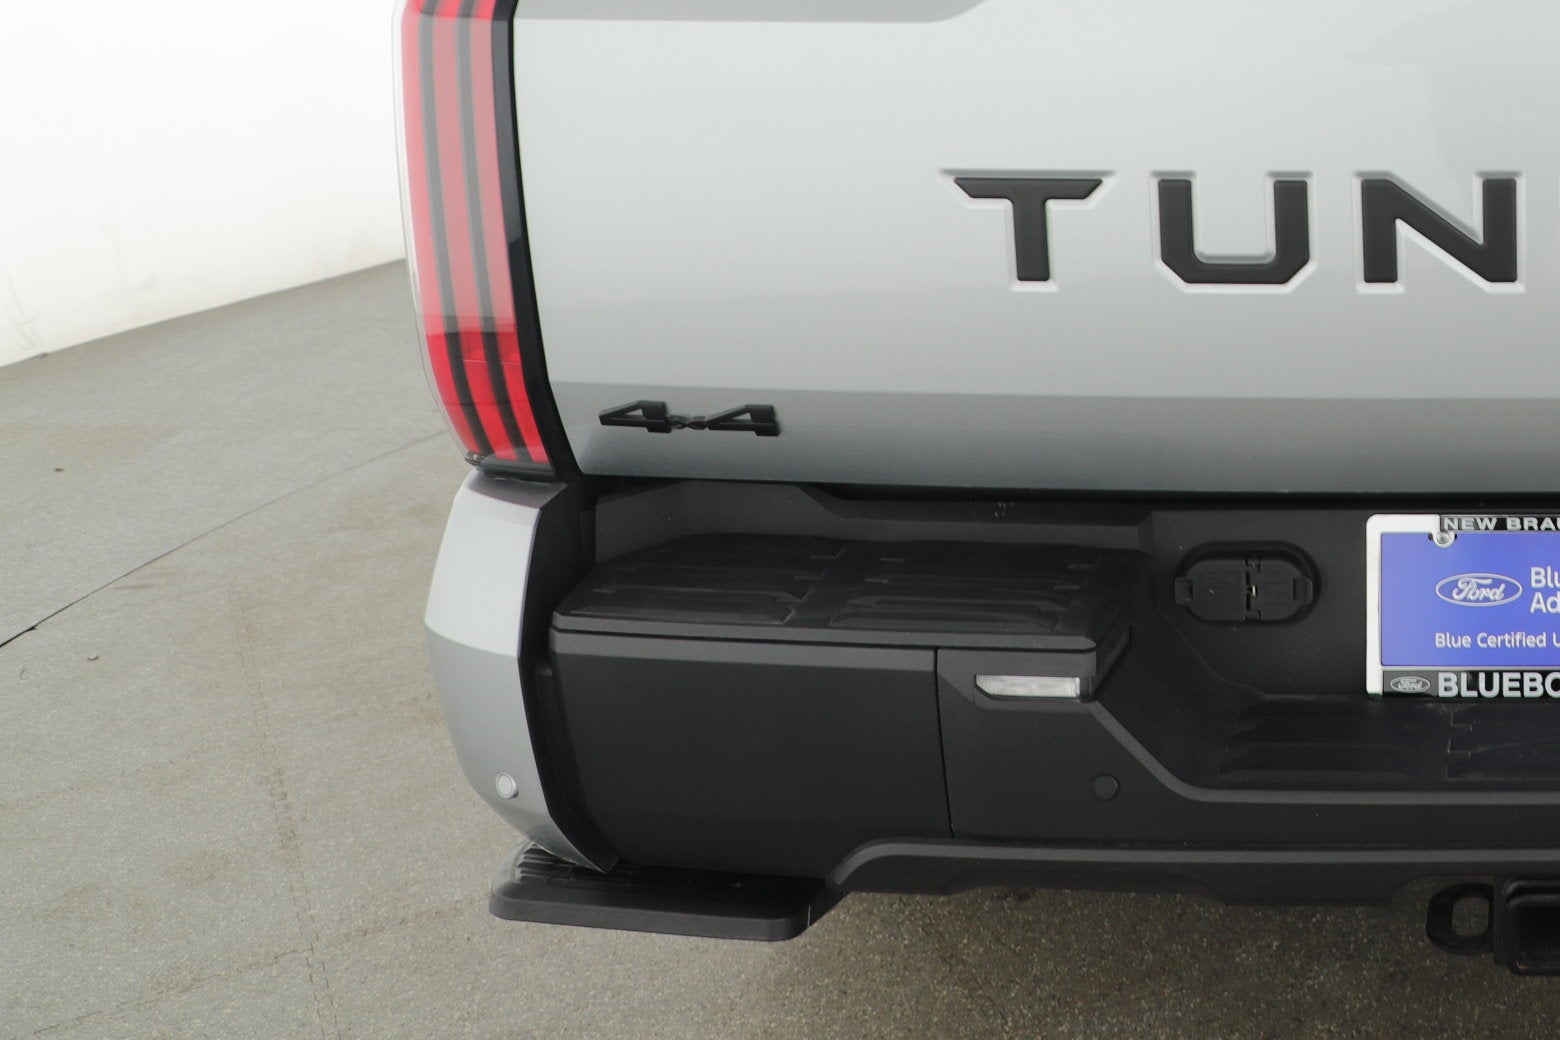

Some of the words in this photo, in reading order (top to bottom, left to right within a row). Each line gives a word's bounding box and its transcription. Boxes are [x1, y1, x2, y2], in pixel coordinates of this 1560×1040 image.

[1442, 516, 1497, 531] NEW
[1451, 577, 1507, 602] Ford
[1434, 631, 1472, 648] Blue
[1476, 631, 1547, 648] Certified
